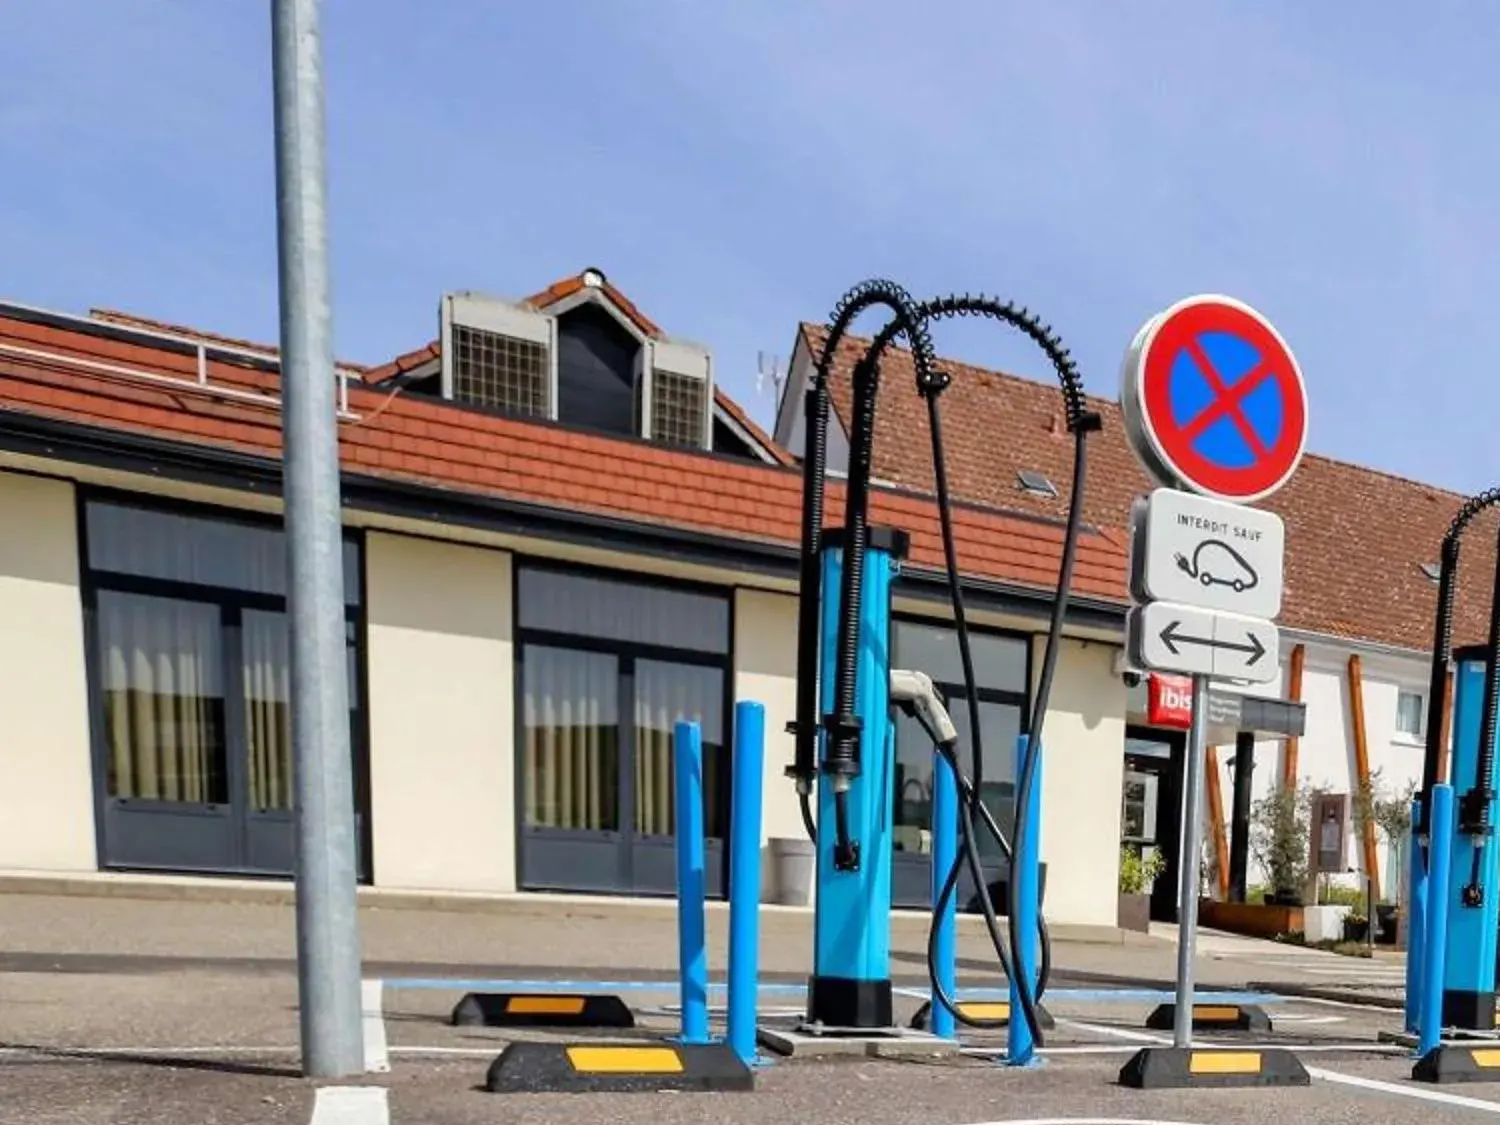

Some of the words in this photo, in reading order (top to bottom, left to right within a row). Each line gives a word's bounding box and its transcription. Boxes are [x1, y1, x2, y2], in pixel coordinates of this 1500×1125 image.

[1177, 513, 1228, 535] INTERDIT
[1233, 526, 1263, 542] SAUF
[1161, 688, 1193, 711] ibis
